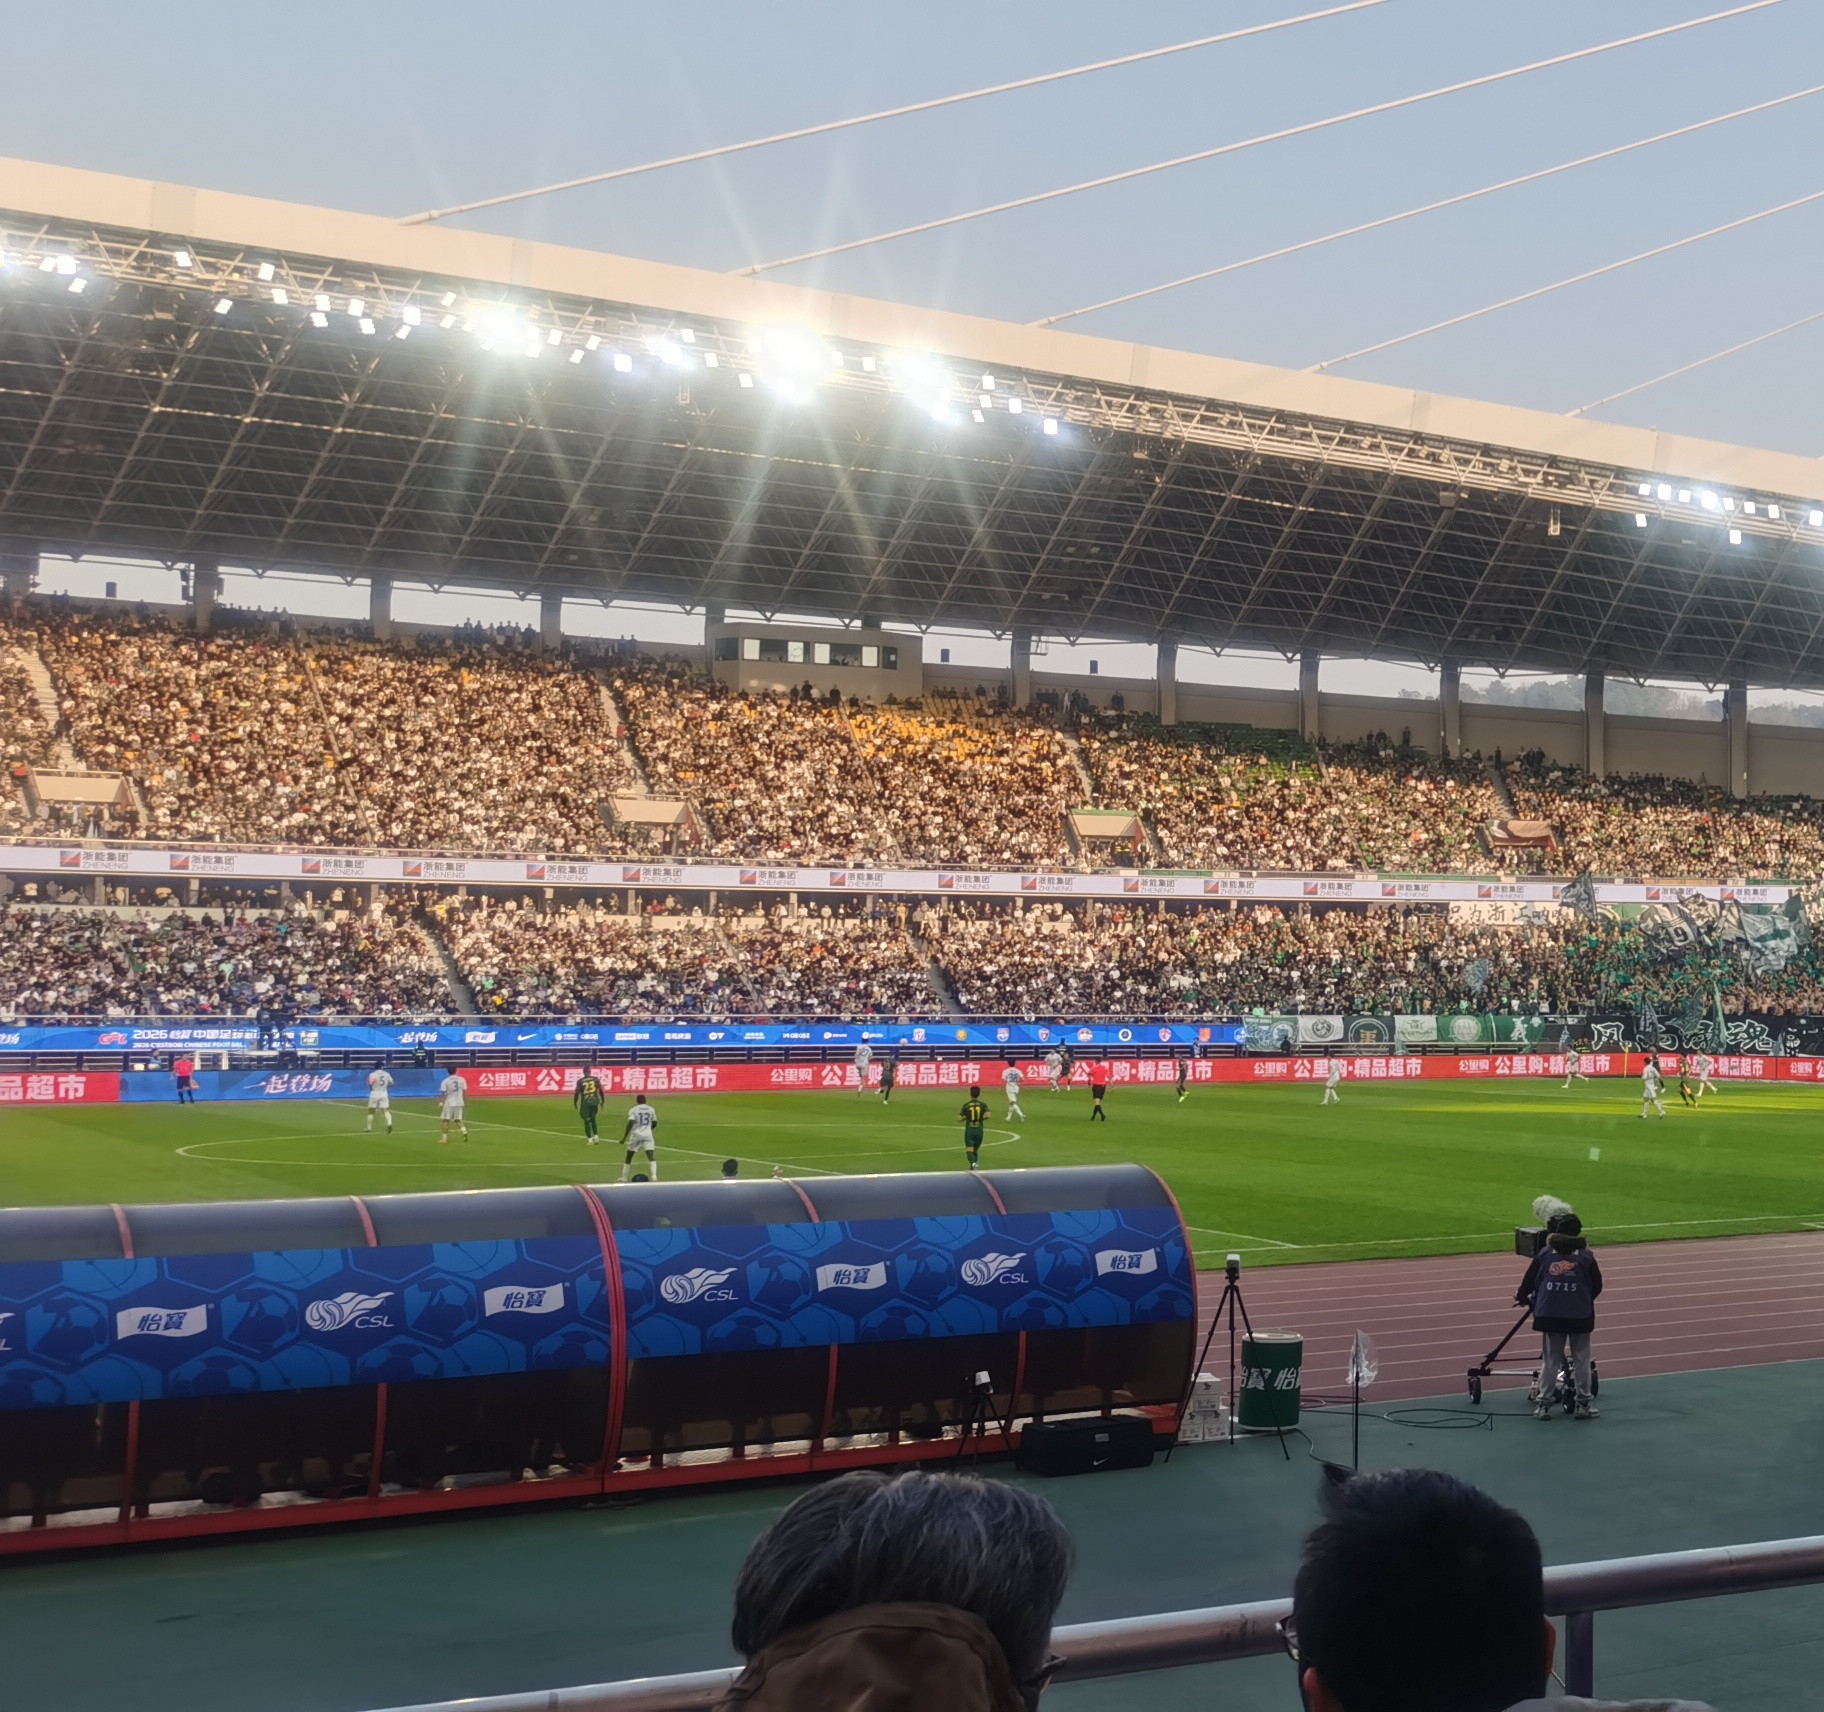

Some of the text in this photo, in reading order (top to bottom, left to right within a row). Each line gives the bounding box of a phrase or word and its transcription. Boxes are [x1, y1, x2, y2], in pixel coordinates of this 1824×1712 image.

[82, 851, 128, 862] 浙能集团
[191, 855, 234, 865] 浙能集团
[322, 859, 364, 869] 浙能集团
[423, 862, 466, 872] 浙能集团
[546, 865, 588, 874] 浙能集团
[642, 867, 682, 876] 浙能集团
[758, 870, 796, 880] 浙能集团
[848, 872, 883, 881] 浙能集团
[956, 875, 990, 883] 浙能集团
[1038, 877, 1073, 885] 浙能集团
[1140, 879, 1175, 887] 浙能集团
[133, 1030, 168, 1039] 2026
[1072, 1060, 1213, 1080] 公购·精品超市
[1254, 1061, 1287, 1075] 公里购
[1459, 1059, 1489, 1072] 公里购
[1790, 1062, 1813, 1074] 公里购
[479, 1072, 527, 1087] 公里购
[771, 1068, 813, 1082] 公里购
[582, 1081, 597, 1094] 23
[969, 1106, 981, 1121] 11
[1111, 1255, 1143, 1271] 怡寶
[833, 1267, 870, 1285] 怡寶
[999, 1272, 1029, 1284] CSL
[1546, 1281, 1577, 1292] 0715
[502, 1289, 548, 1309] 怡寶
[704, 1288, 739, 1302] CSL
[137, 1311, 188, 1333] 怡寶
[354, 1315, 394, 1329] CSL
